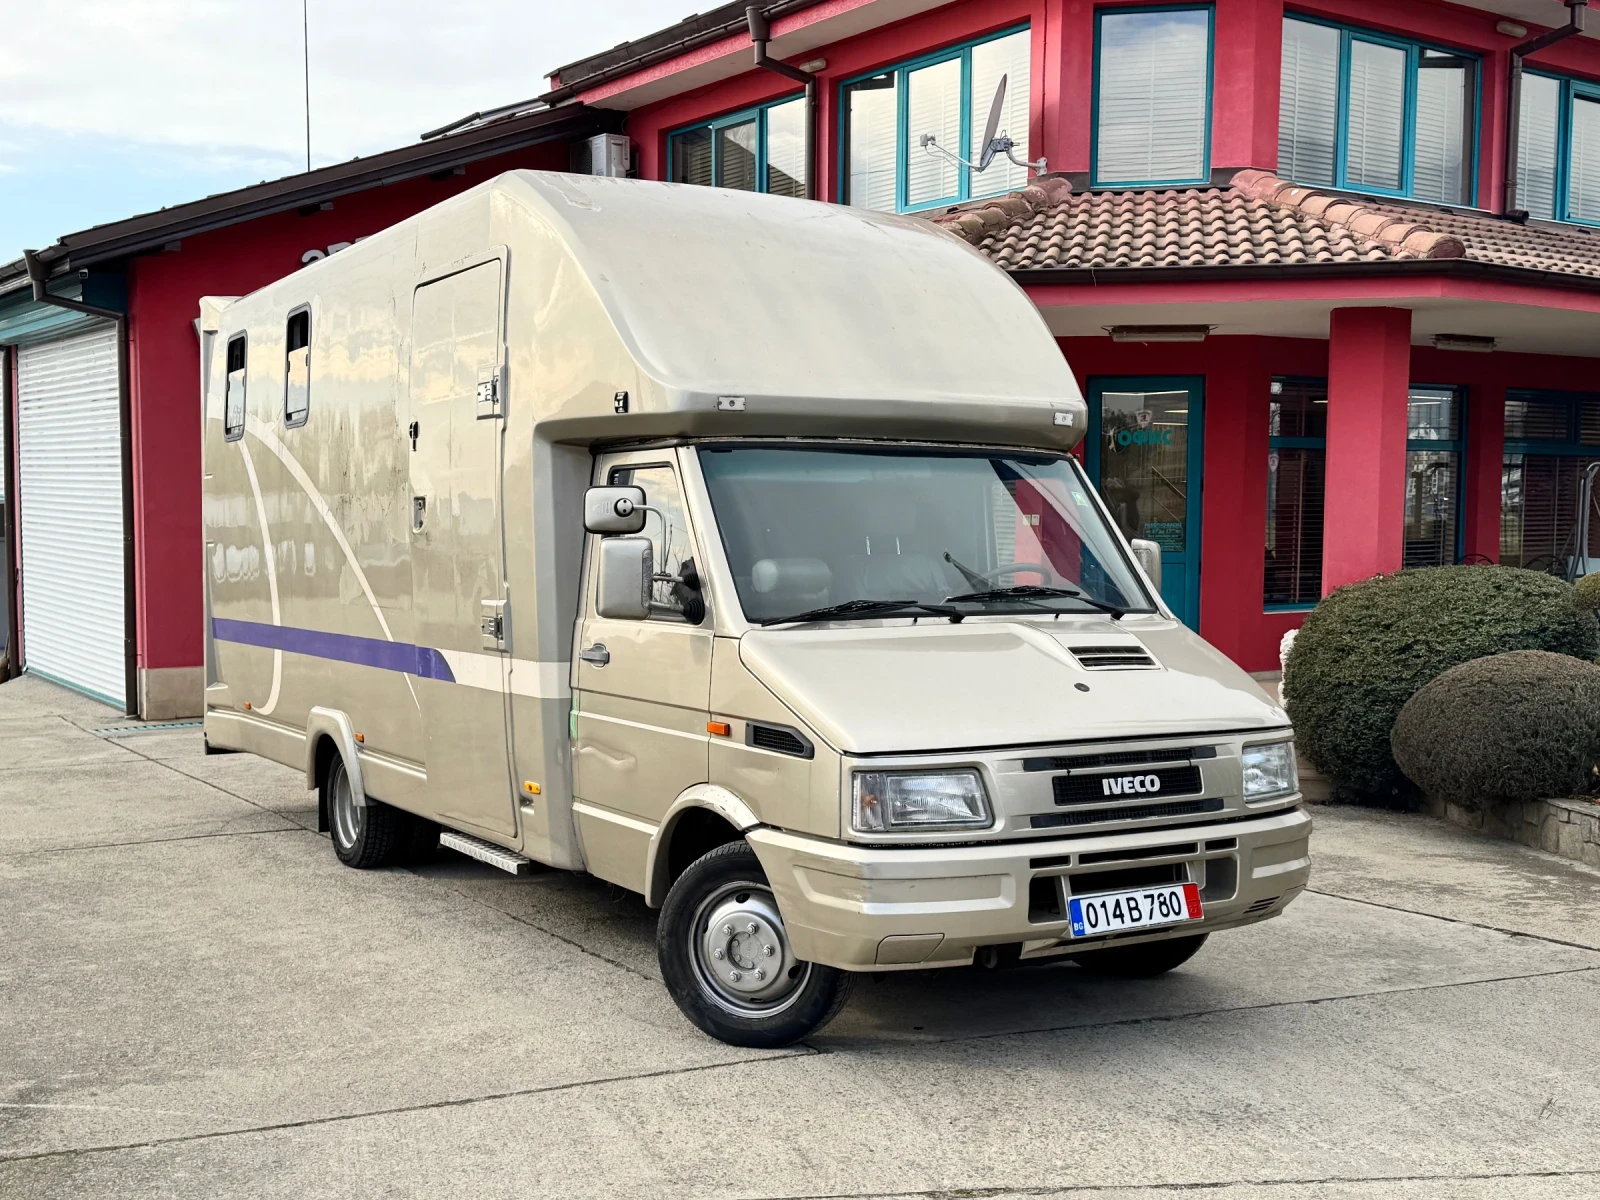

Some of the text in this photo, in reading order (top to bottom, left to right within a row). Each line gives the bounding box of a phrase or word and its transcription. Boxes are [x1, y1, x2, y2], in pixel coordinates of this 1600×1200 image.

[1118, 429, 1173, 446] ОФИС
[1102, 774, 1160, 796] IVECO
[1073, 922, 1084, 931] BG
